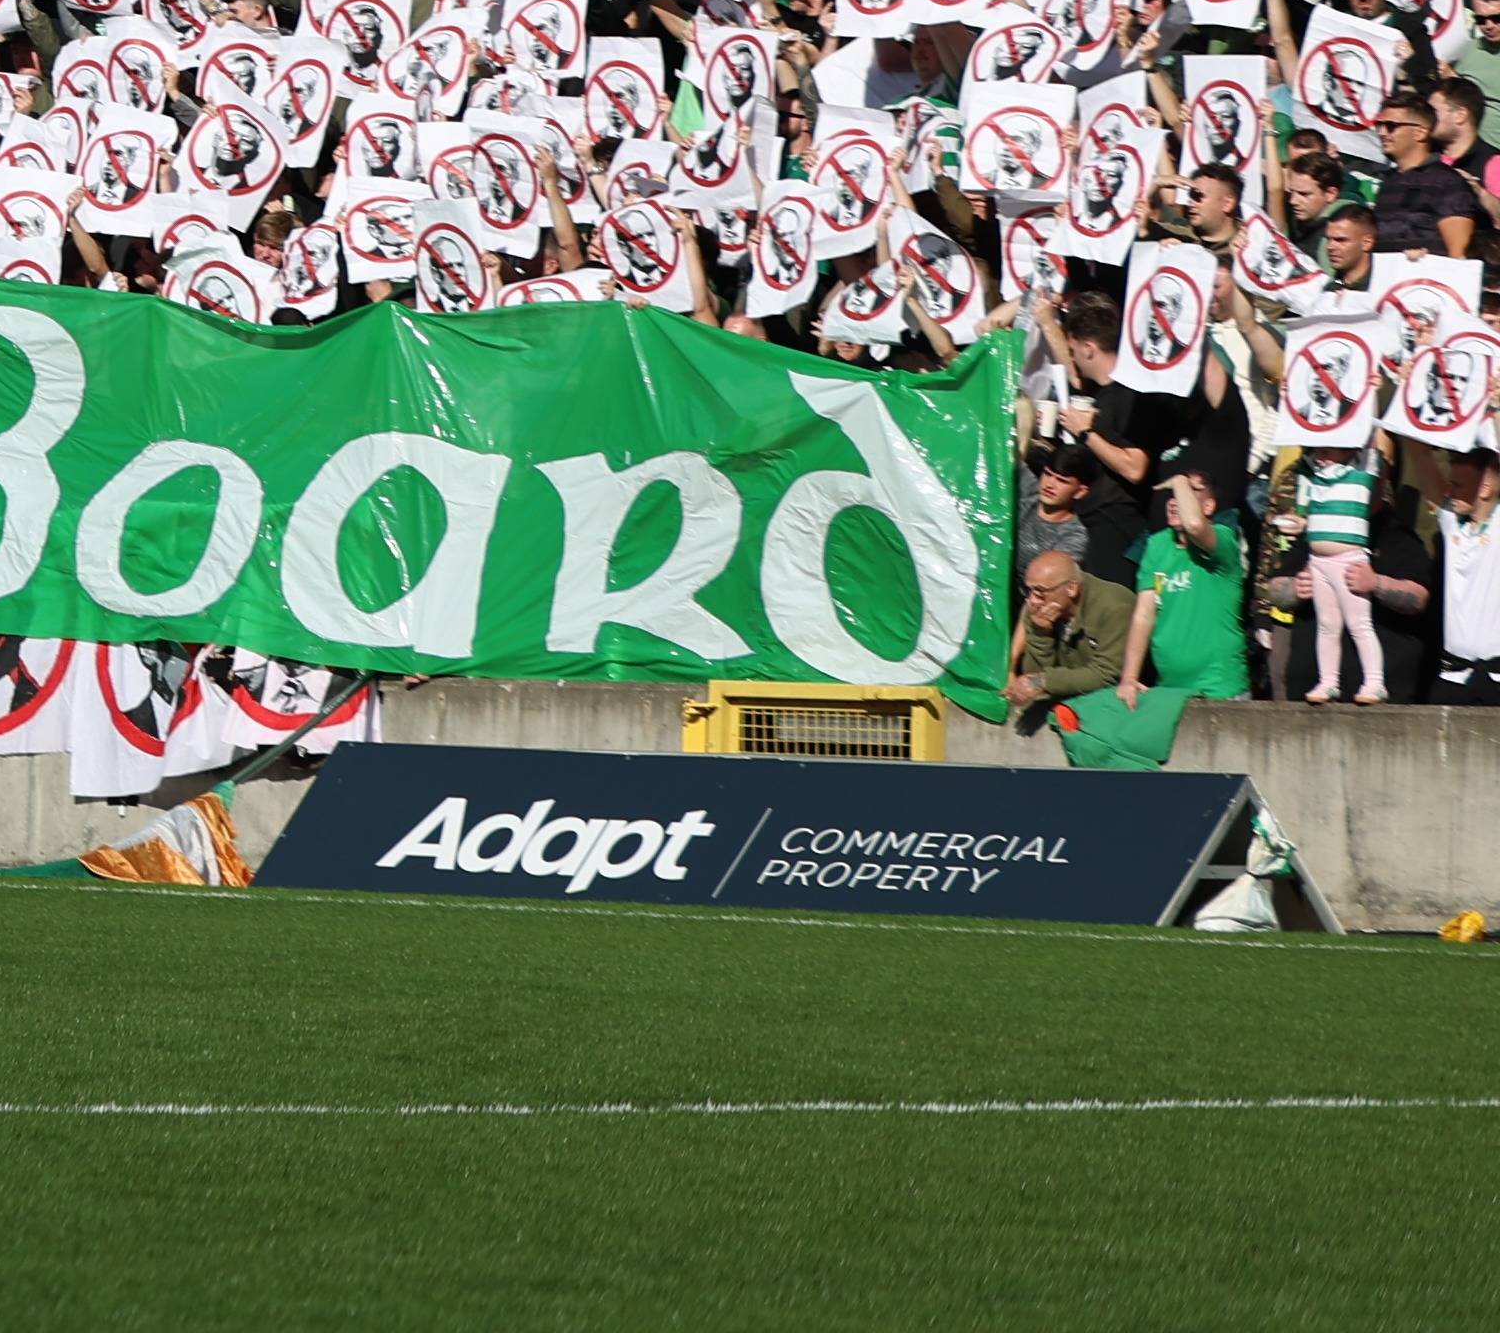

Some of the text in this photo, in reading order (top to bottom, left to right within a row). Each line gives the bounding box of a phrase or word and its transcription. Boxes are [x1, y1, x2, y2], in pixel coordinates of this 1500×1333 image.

[375, 796, 1071, 895] Adapt COMMERCIAL
[756, 860, 1002, 896] PROPERTY
